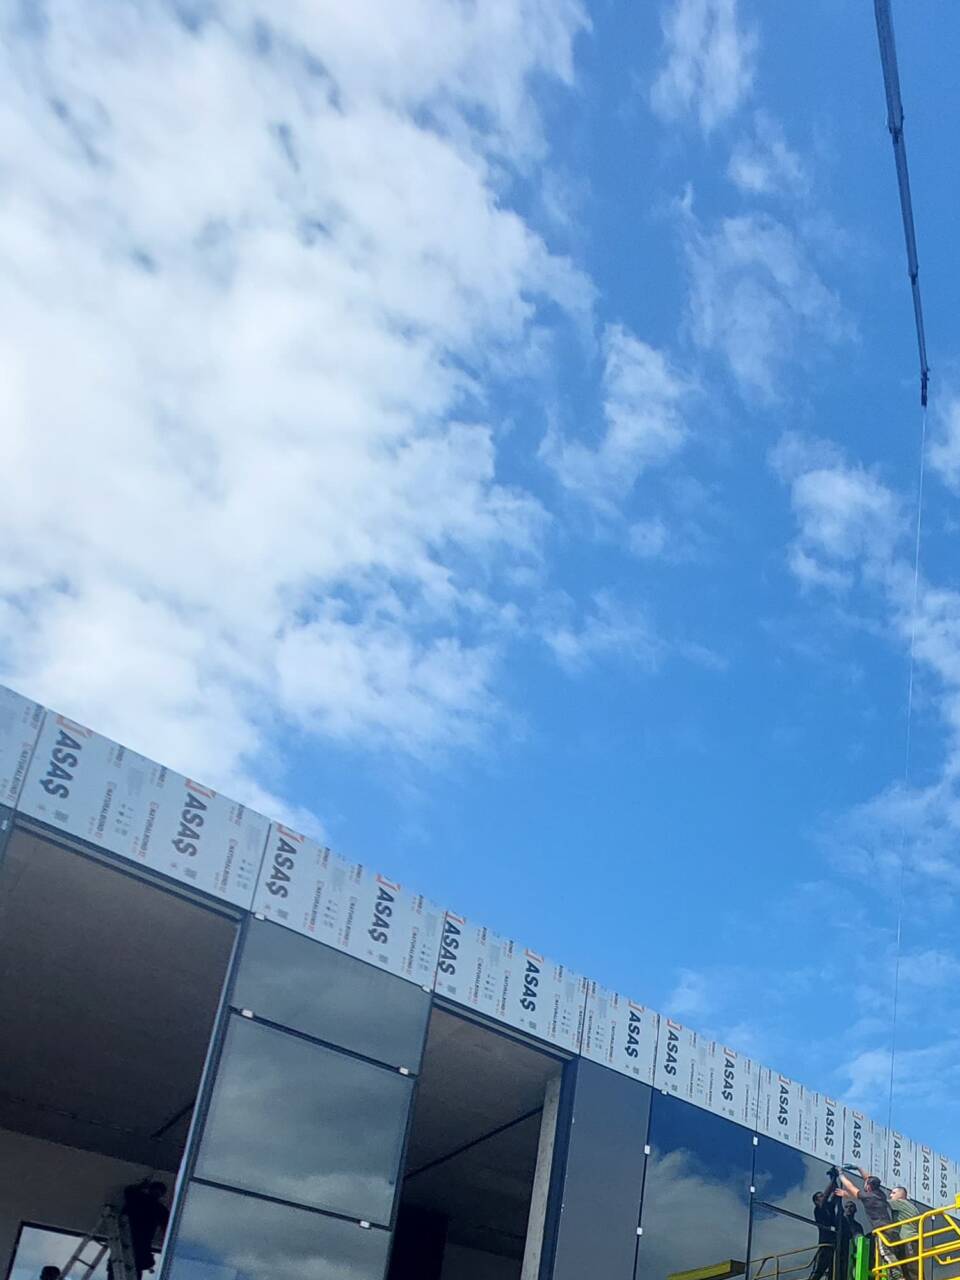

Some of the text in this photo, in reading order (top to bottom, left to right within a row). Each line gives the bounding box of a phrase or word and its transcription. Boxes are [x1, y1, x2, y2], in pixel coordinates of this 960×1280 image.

[39, 730, 82, 799] ASAŞ
[172, 792, 207, 856] ASAŞ
[265, 837, 297, 898] ASAŞ
[368, 887, 395, 944] ASAŞ
[438, 920, 461, 976] ASAŞ
[520, 960, 540, 1012] ASAŞ
[625, 1011, 641, 1058] ASAŞ
[664, 1030, 680, 1076] ASAŞ
[722, 1058, 735, 1102] ASAŞ
[777, 1084, 789, 1126] ASAŞ
[824, 1107, 835, 1147] ASAŞ
[852, 1120, 862, 1159] ASAŞ
